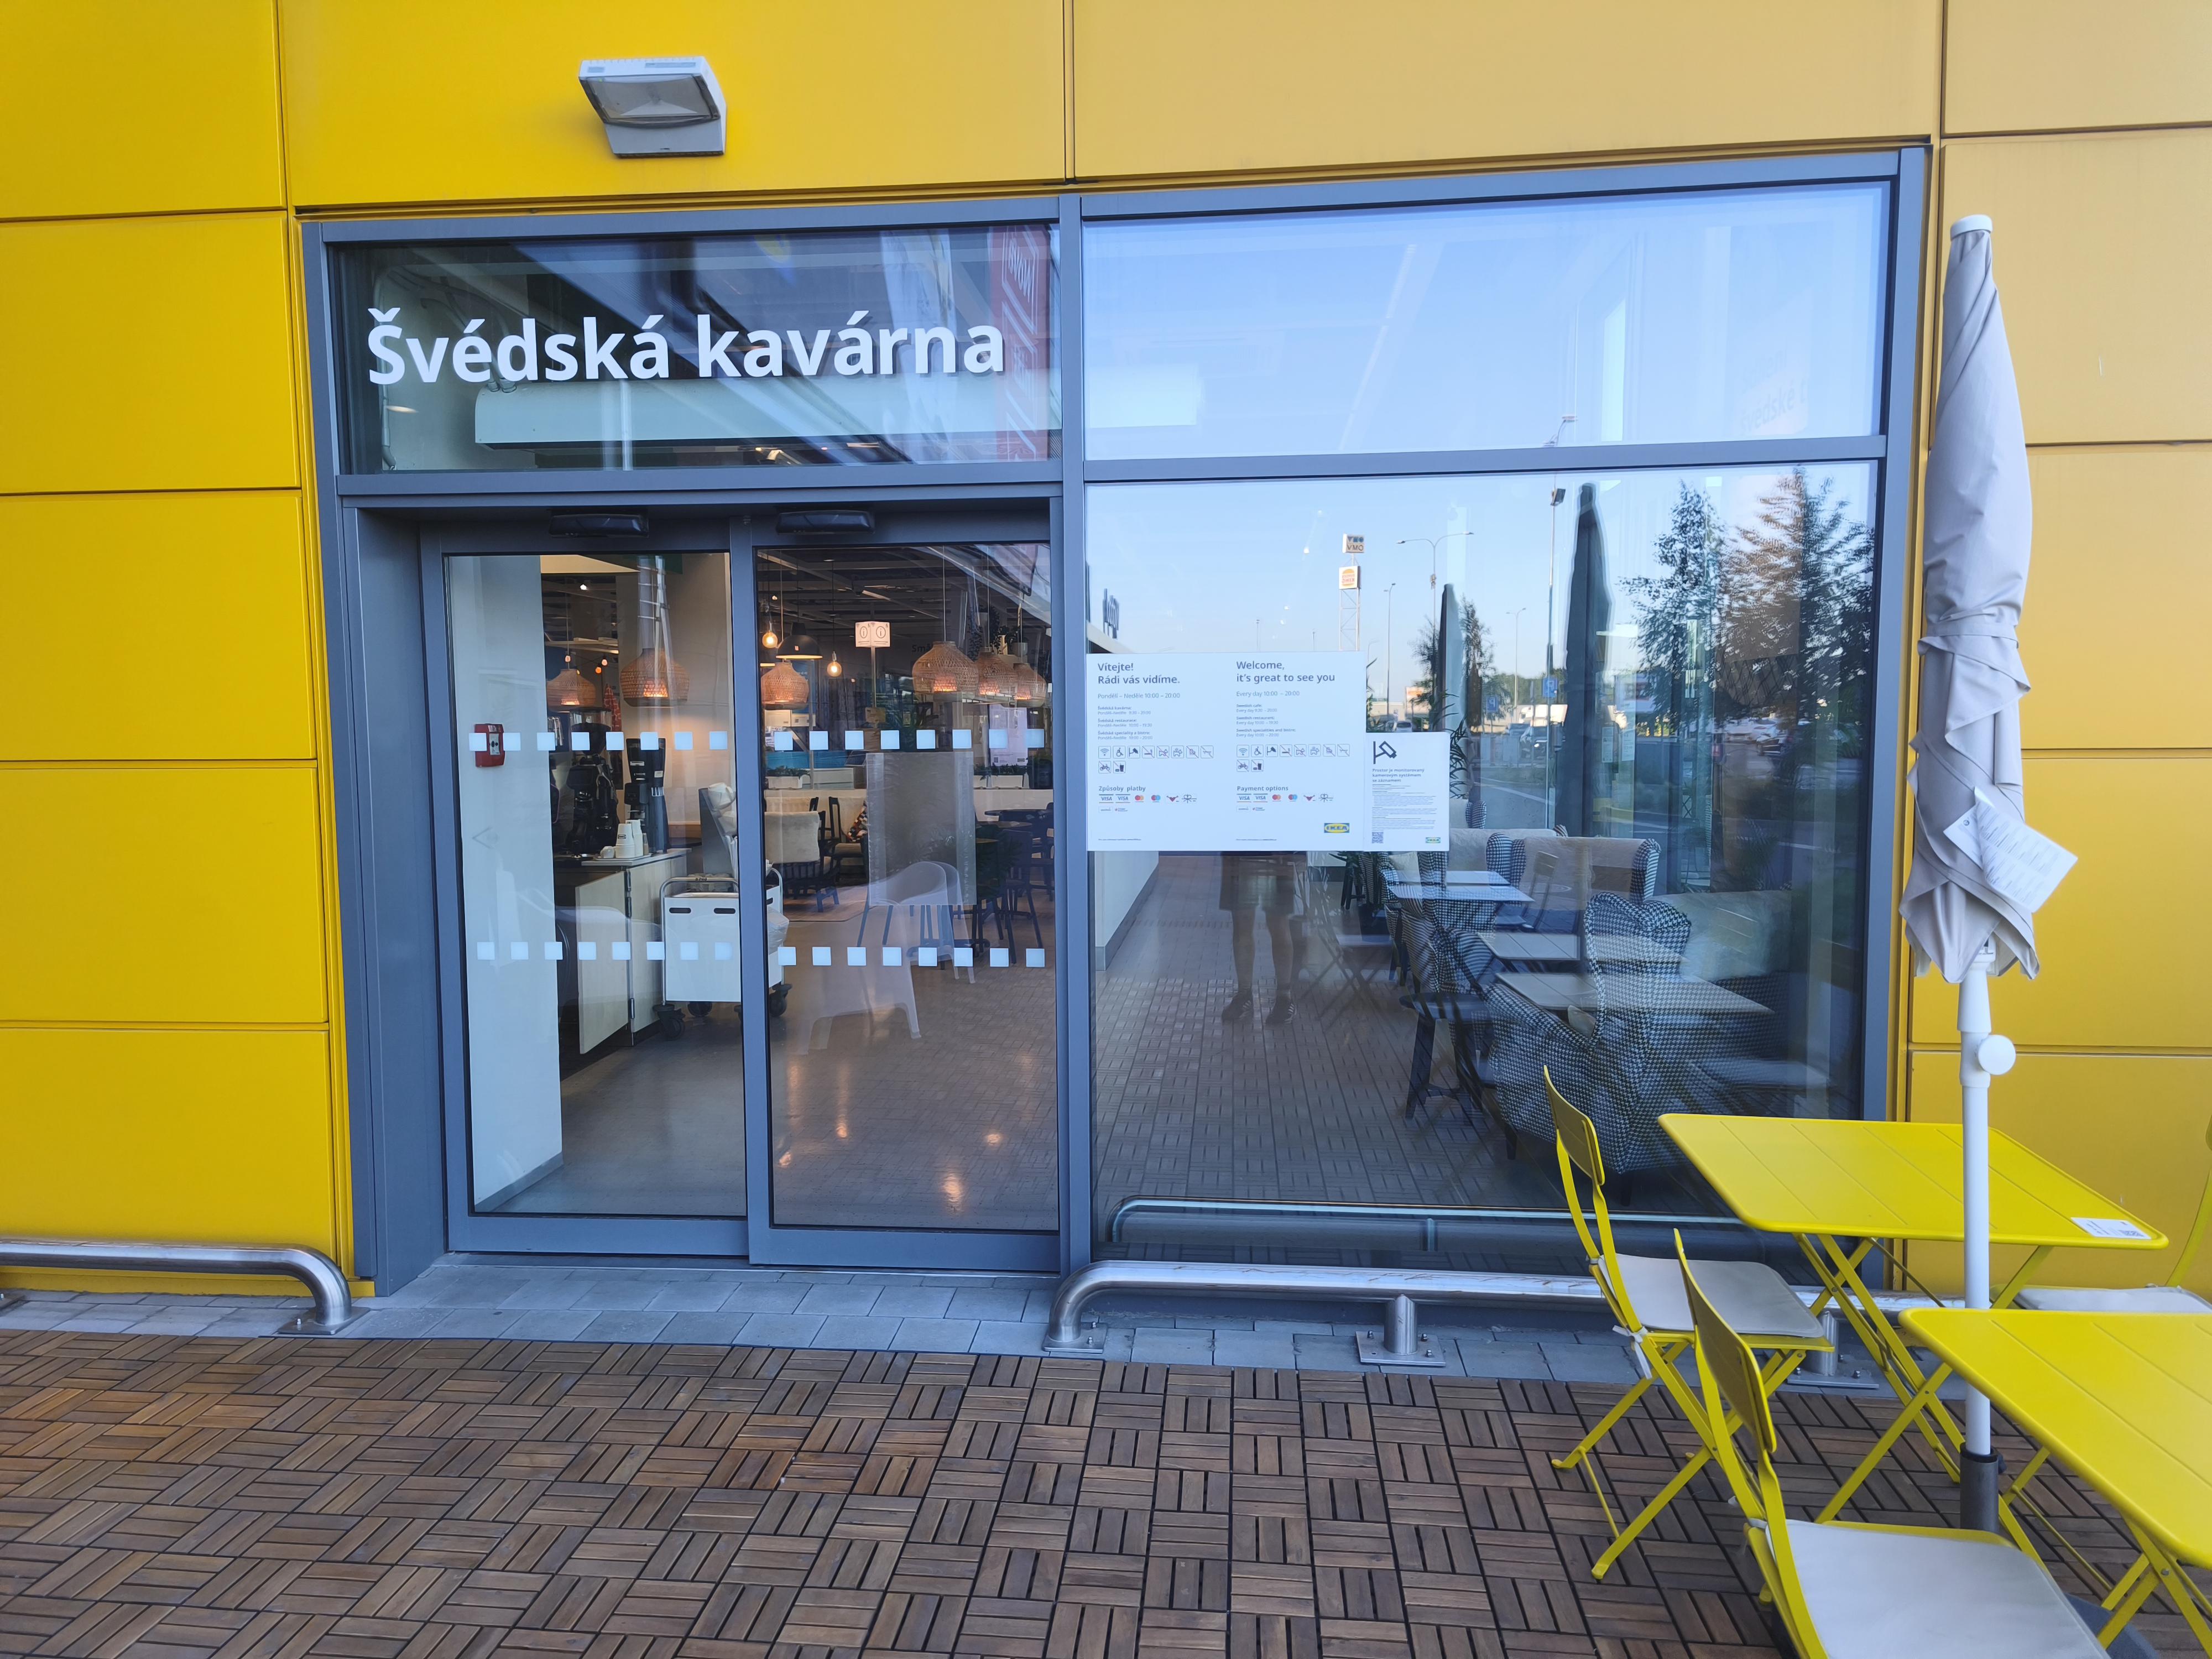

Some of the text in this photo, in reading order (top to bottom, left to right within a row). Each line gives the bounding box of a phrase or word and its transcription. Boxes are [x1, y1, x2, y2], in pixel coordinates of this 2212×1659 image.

[367, 306, 670, 386] Švédská
[697, 310, 1005, 378] kavárna
[1098, 662, 1134, 673] Vítejte!
[1237, 661, 1285, 670] Welcome,
[1098, 675, 1180, 684] Rádi vás vidíme.
[1254, 674, 1281, 684] great
[1317, 675, 1335, 684] you
